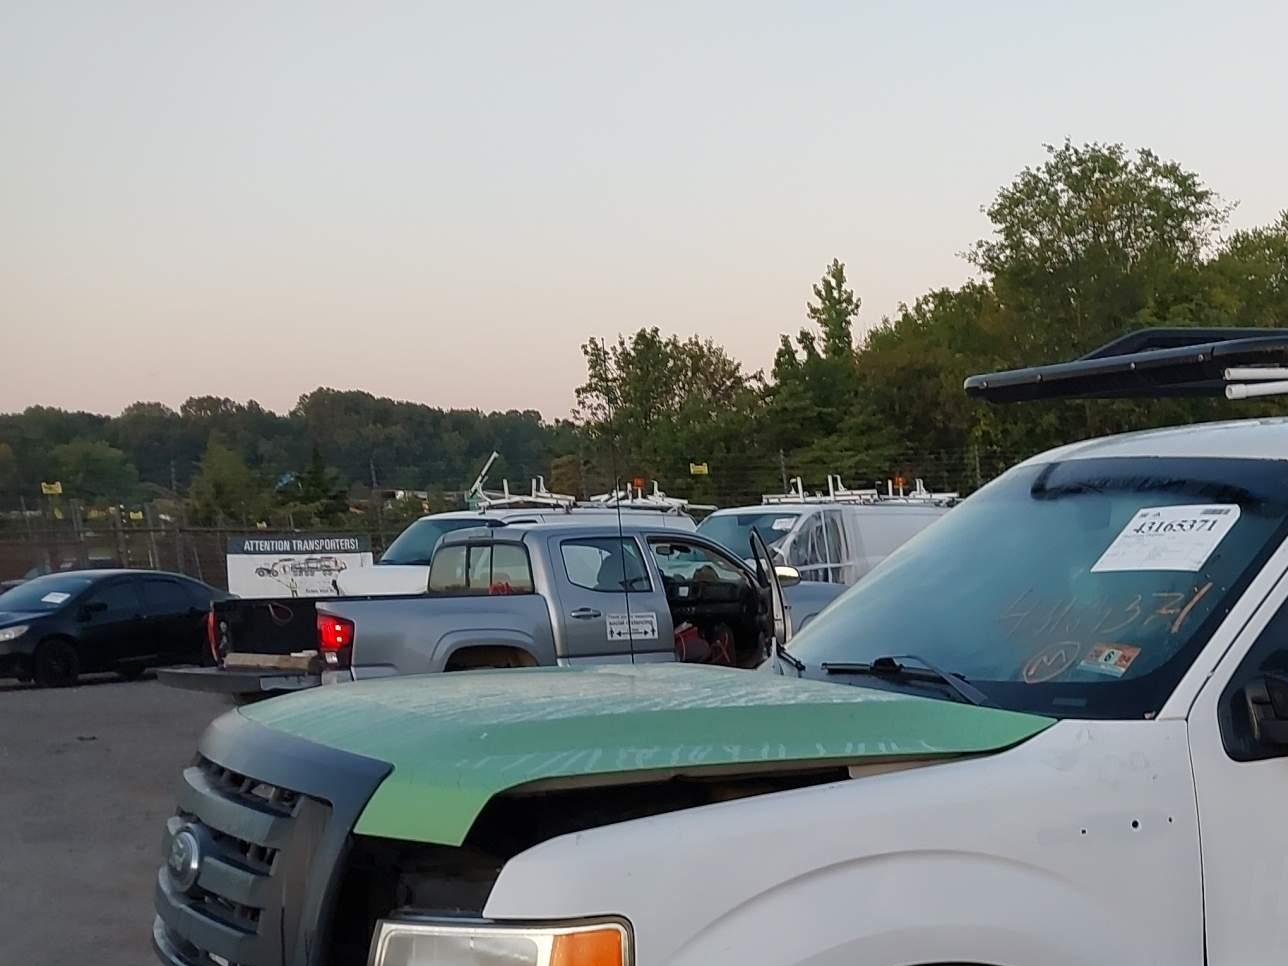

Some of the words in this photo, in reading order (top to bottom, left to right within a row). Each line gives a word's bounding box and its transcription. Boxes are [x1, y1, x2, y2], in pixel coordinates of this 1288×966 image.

[1133, 518, 1218, 534] 43165371
[243, 539, 291, 552] ATTENTION
[292, 537, 359, 551] TRANSPORTERS!
